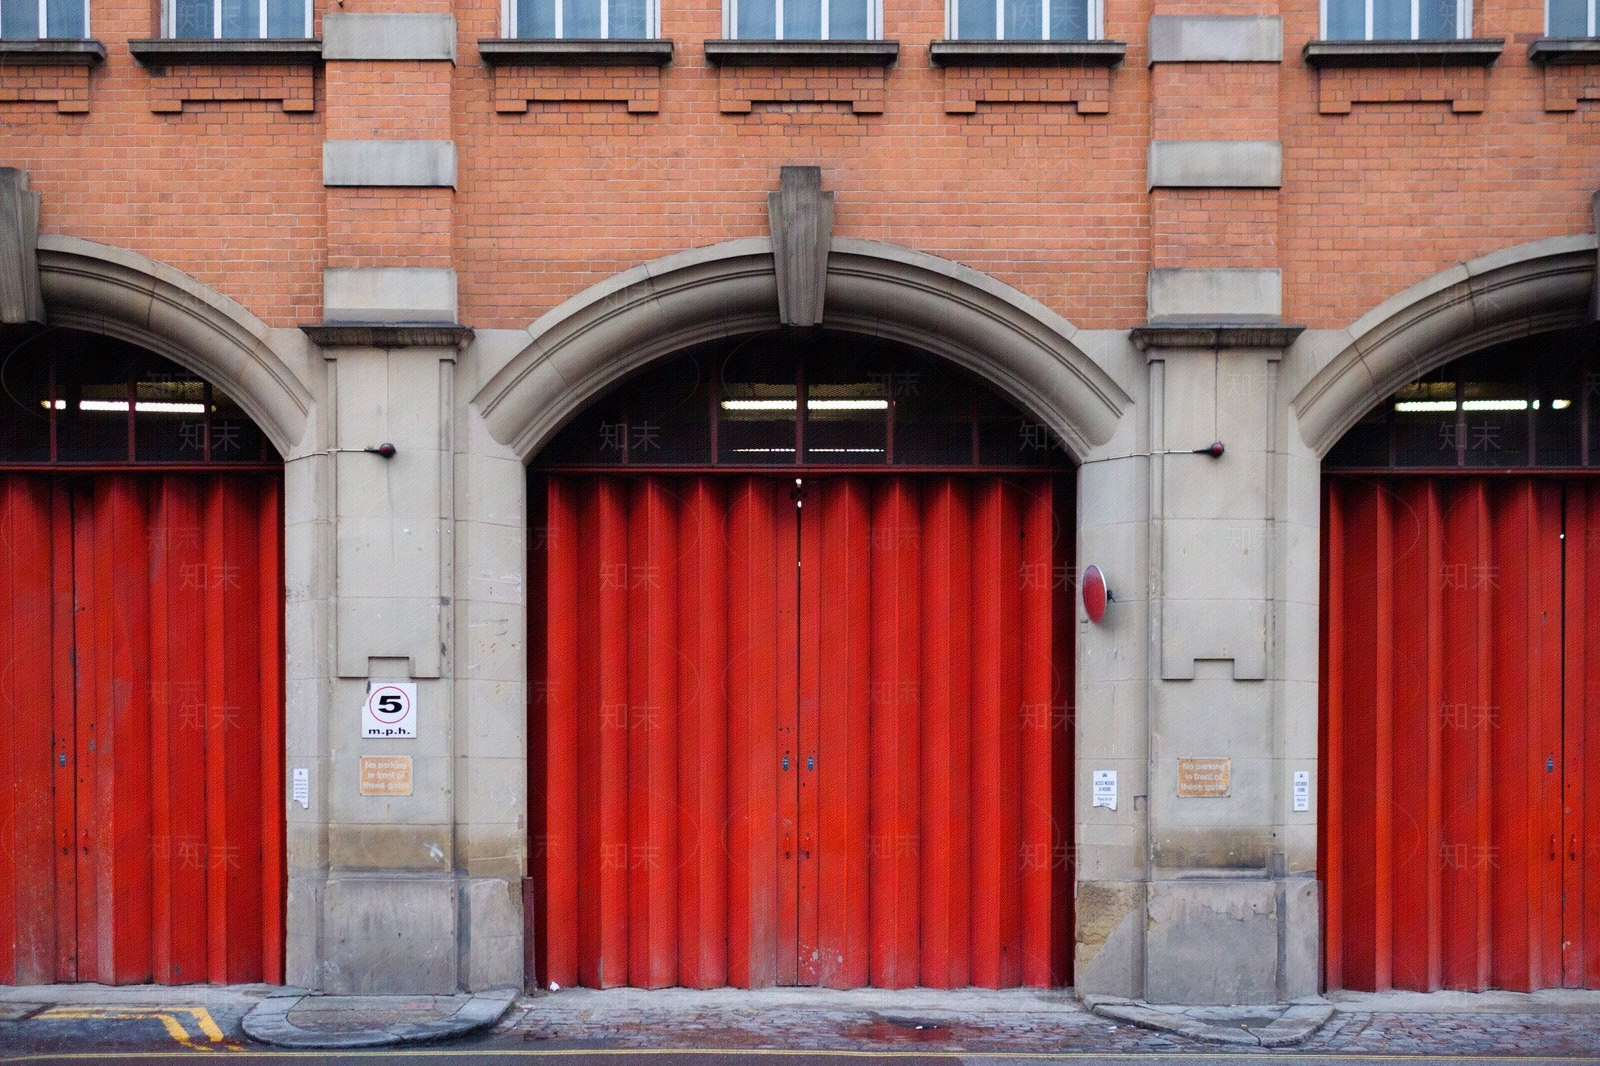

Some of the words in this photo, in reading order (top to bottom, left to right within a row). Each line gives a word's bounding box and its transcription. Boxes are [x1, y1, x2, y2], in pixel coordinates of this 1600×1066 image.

[378, 695, 403, 713] 5
[368, 727, 410, 736] m.p.h.
[1195, 763, 1225, 771] parking
